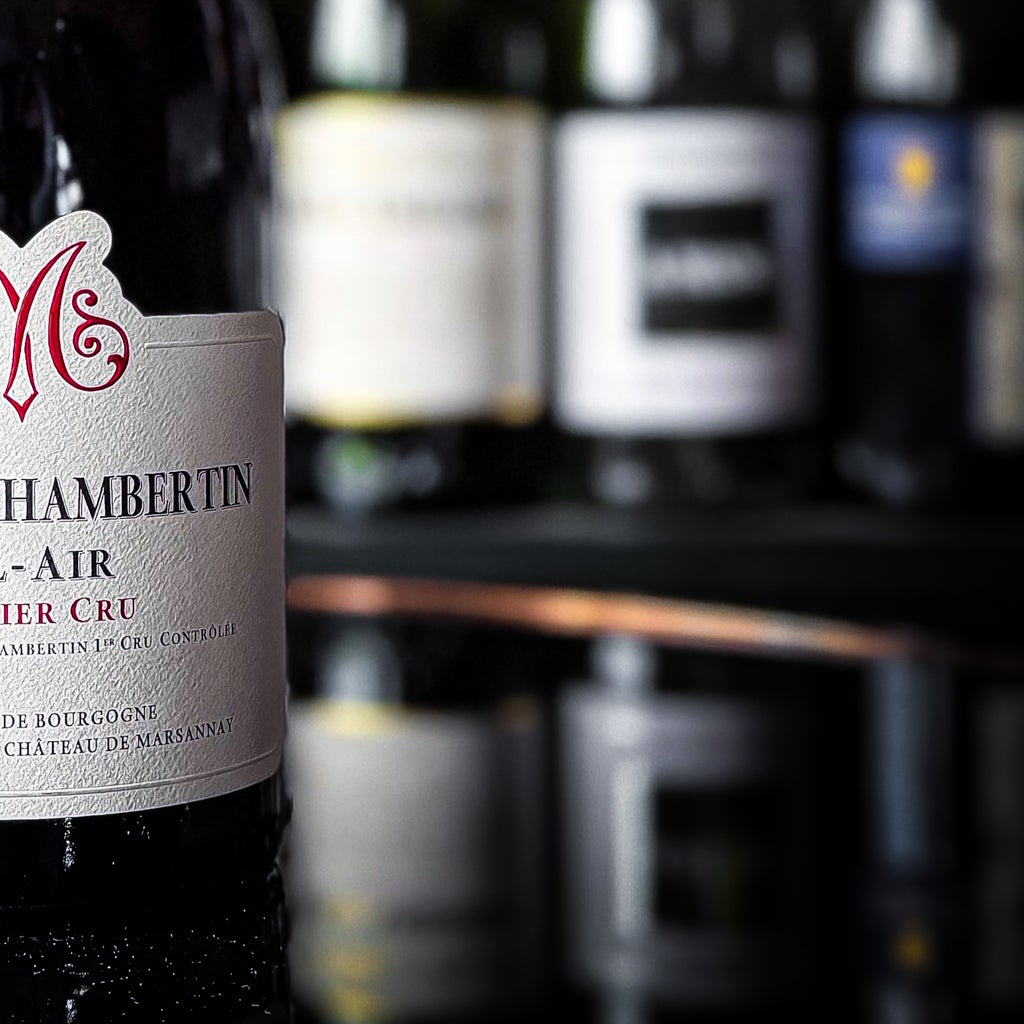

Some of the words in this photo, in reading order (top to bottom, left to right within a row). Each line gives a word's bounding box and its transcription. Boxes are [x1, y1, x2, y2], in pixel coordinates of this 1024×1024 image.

[69, 596, 138, 624] CRU
[120, 635, 153, 651] CRU
[159, 620, 237, 647] CONTRÔLÉE
[1, 713, 28, 729] DE
[35, 704, 158, 729] BOURGOGNE
[3, 738, 98, 757] CHÂTEAU
[105, 735, 130, 752] DE
[135, 717, 235, 749] MARSANNAY
